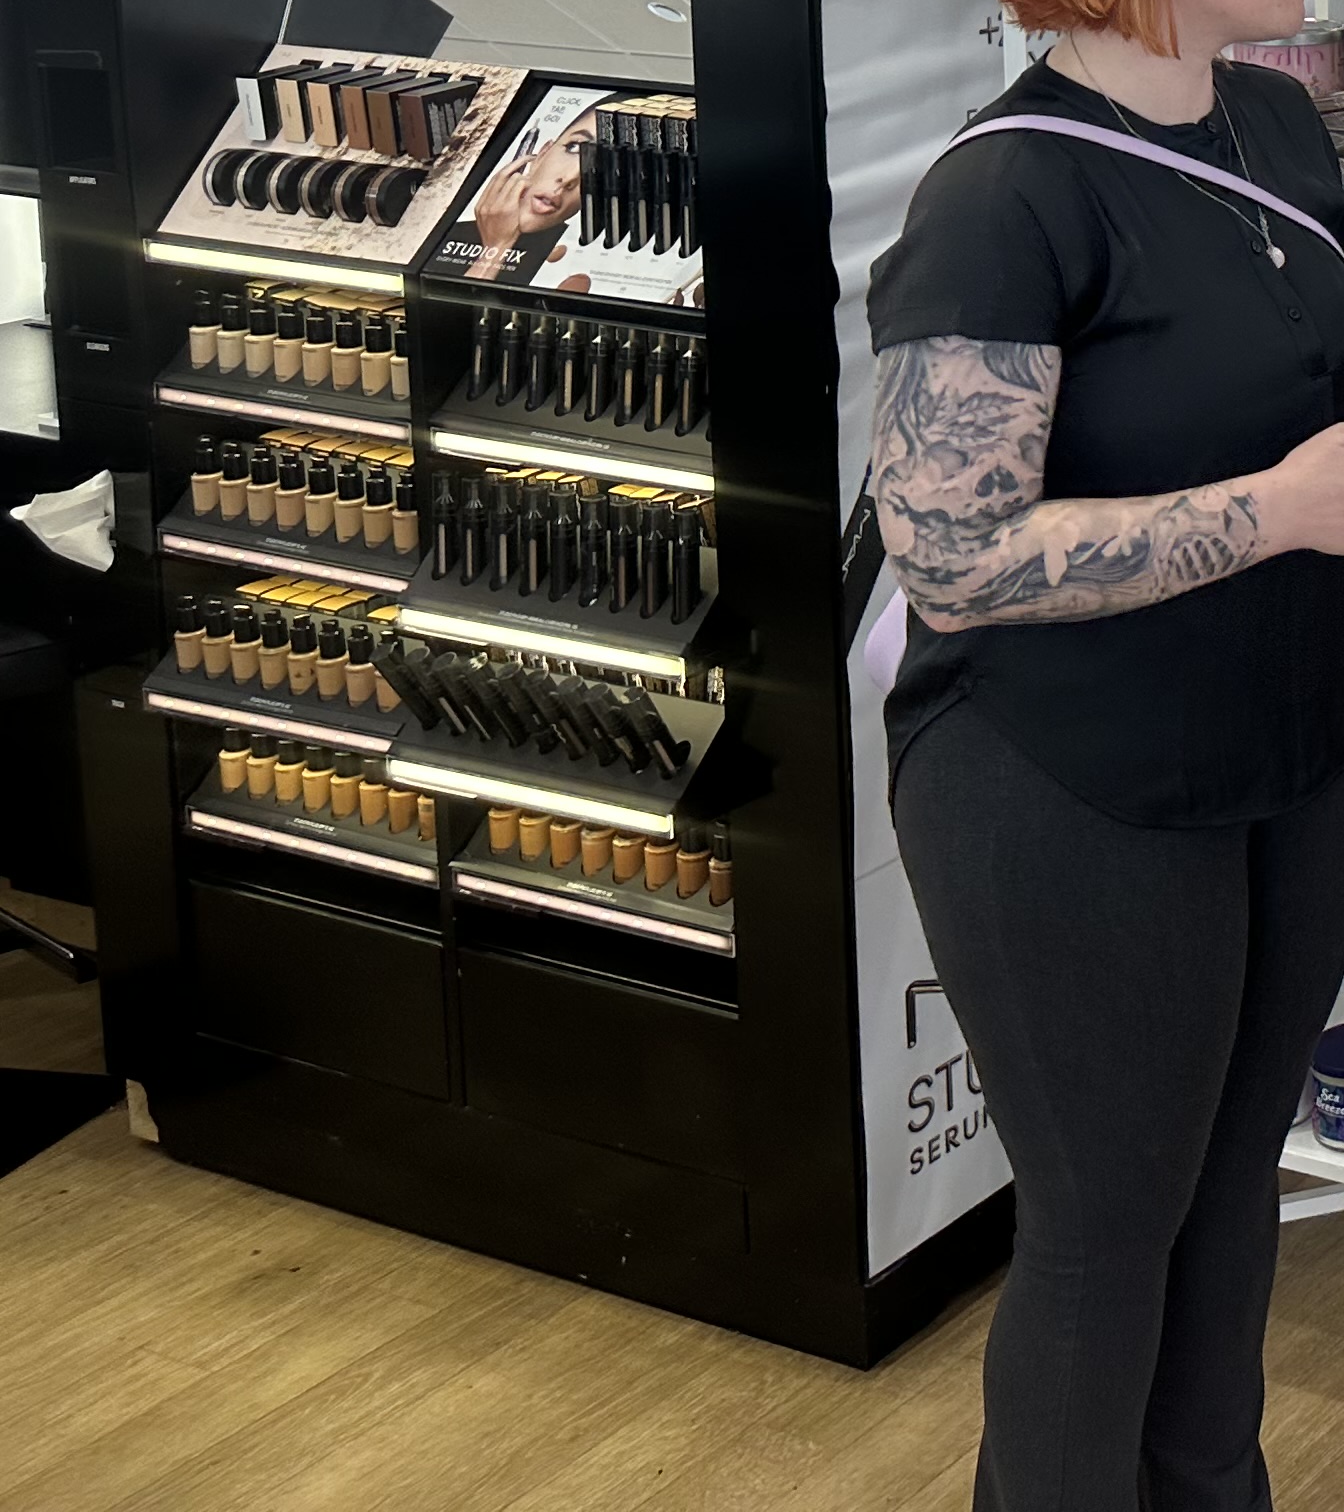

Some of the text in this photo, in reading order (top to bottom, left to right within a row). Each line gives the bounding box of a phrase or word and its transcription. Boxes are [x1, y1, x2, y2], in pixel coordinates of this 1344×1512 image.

[442, 240, 527, 264] STUDIO FIX
[1320, 1088, 1339, 1103] Sea
[908, 1104, 990, 1176] SERU
